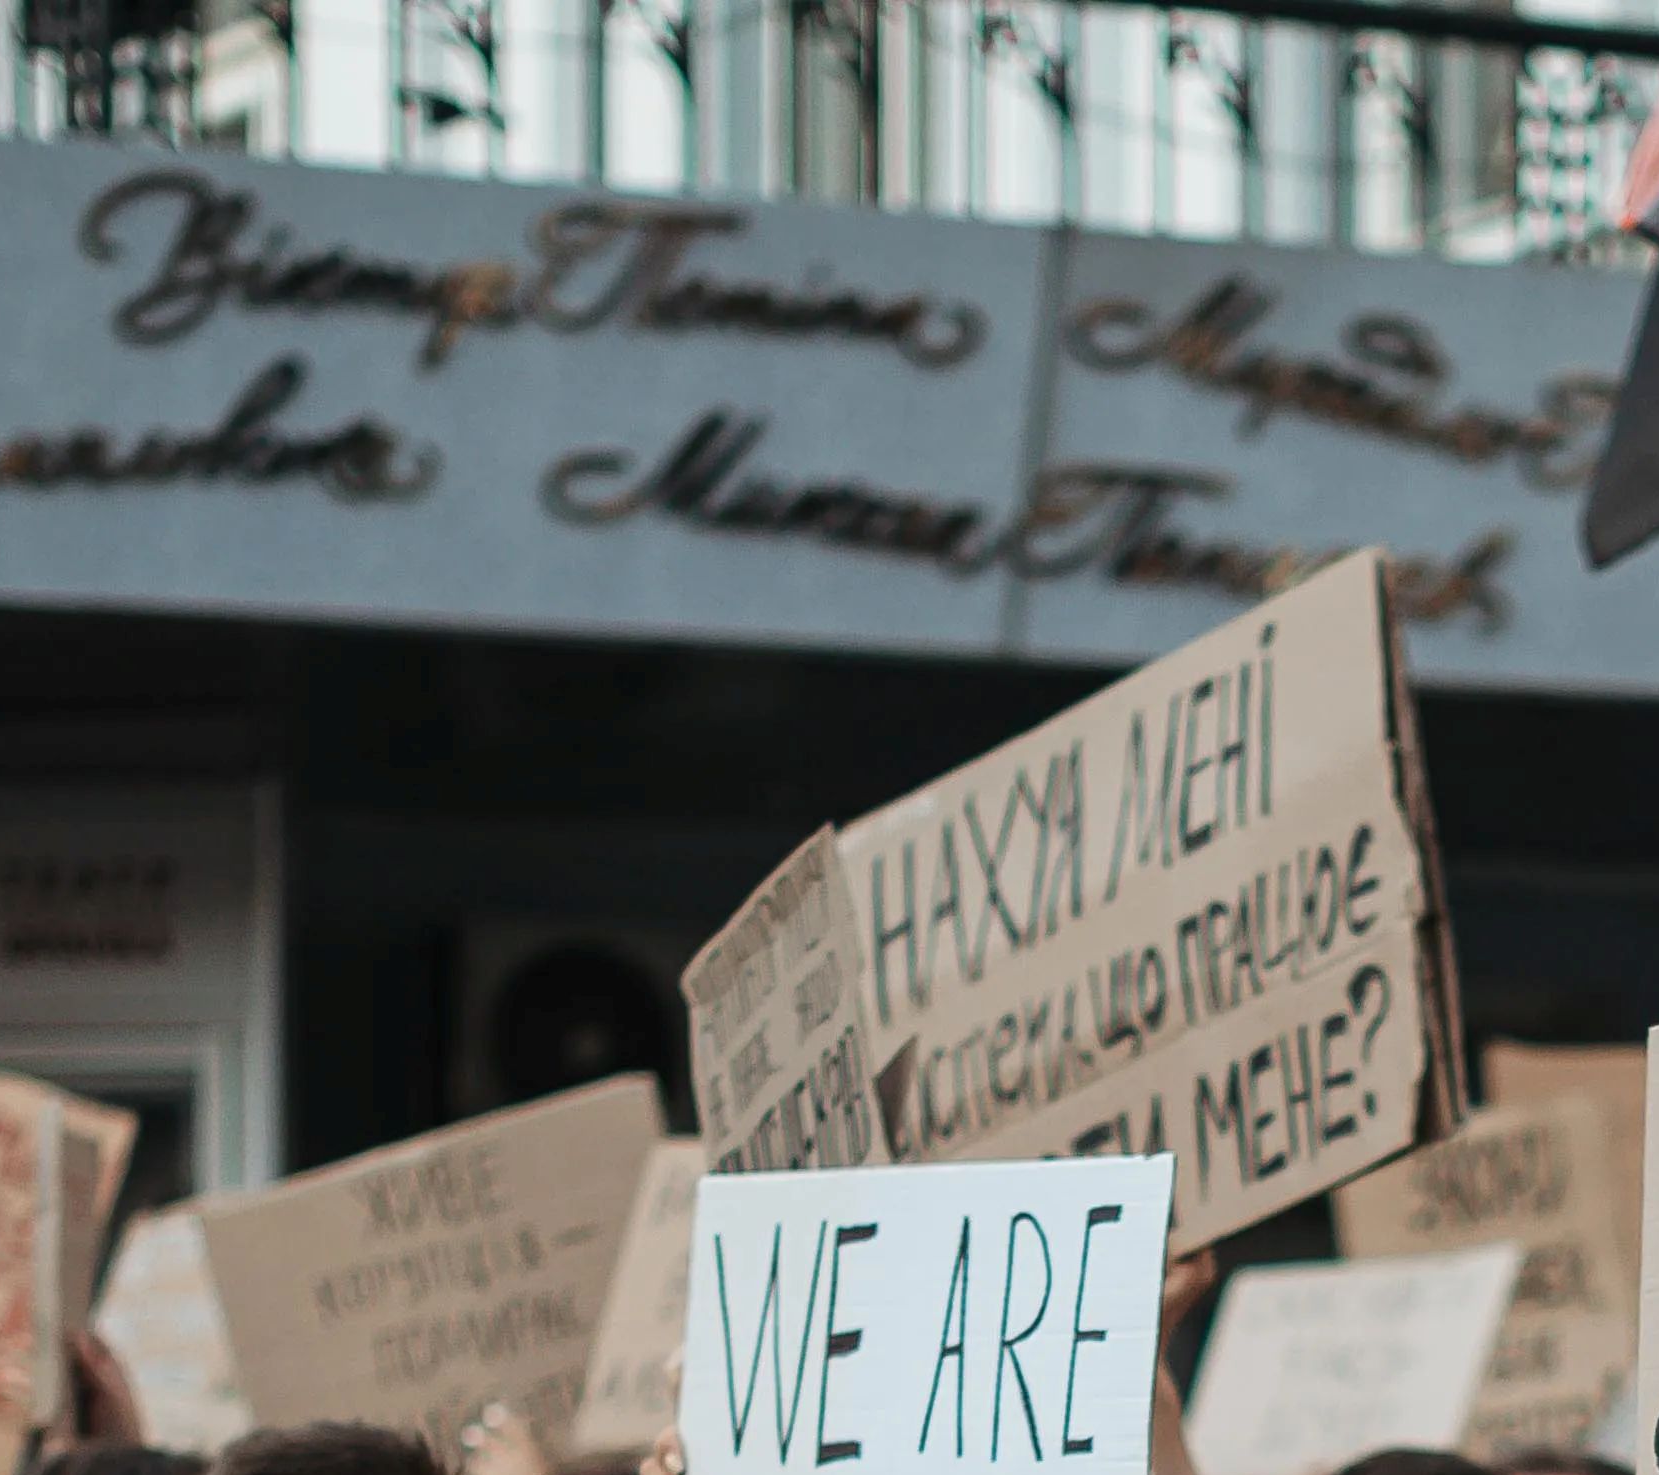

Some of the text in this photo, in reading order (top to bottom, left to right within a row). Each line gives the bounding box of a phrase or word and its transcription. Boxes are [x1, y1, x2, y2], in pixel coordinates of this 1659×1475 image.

[1101, 622, 1281, 908] МЕНІ
[1195, 962, 1395, 1204] МЕНЕ?
[713, 1215, 880, 1469] WE
[917, 1203, 1124, 1465] ARE
